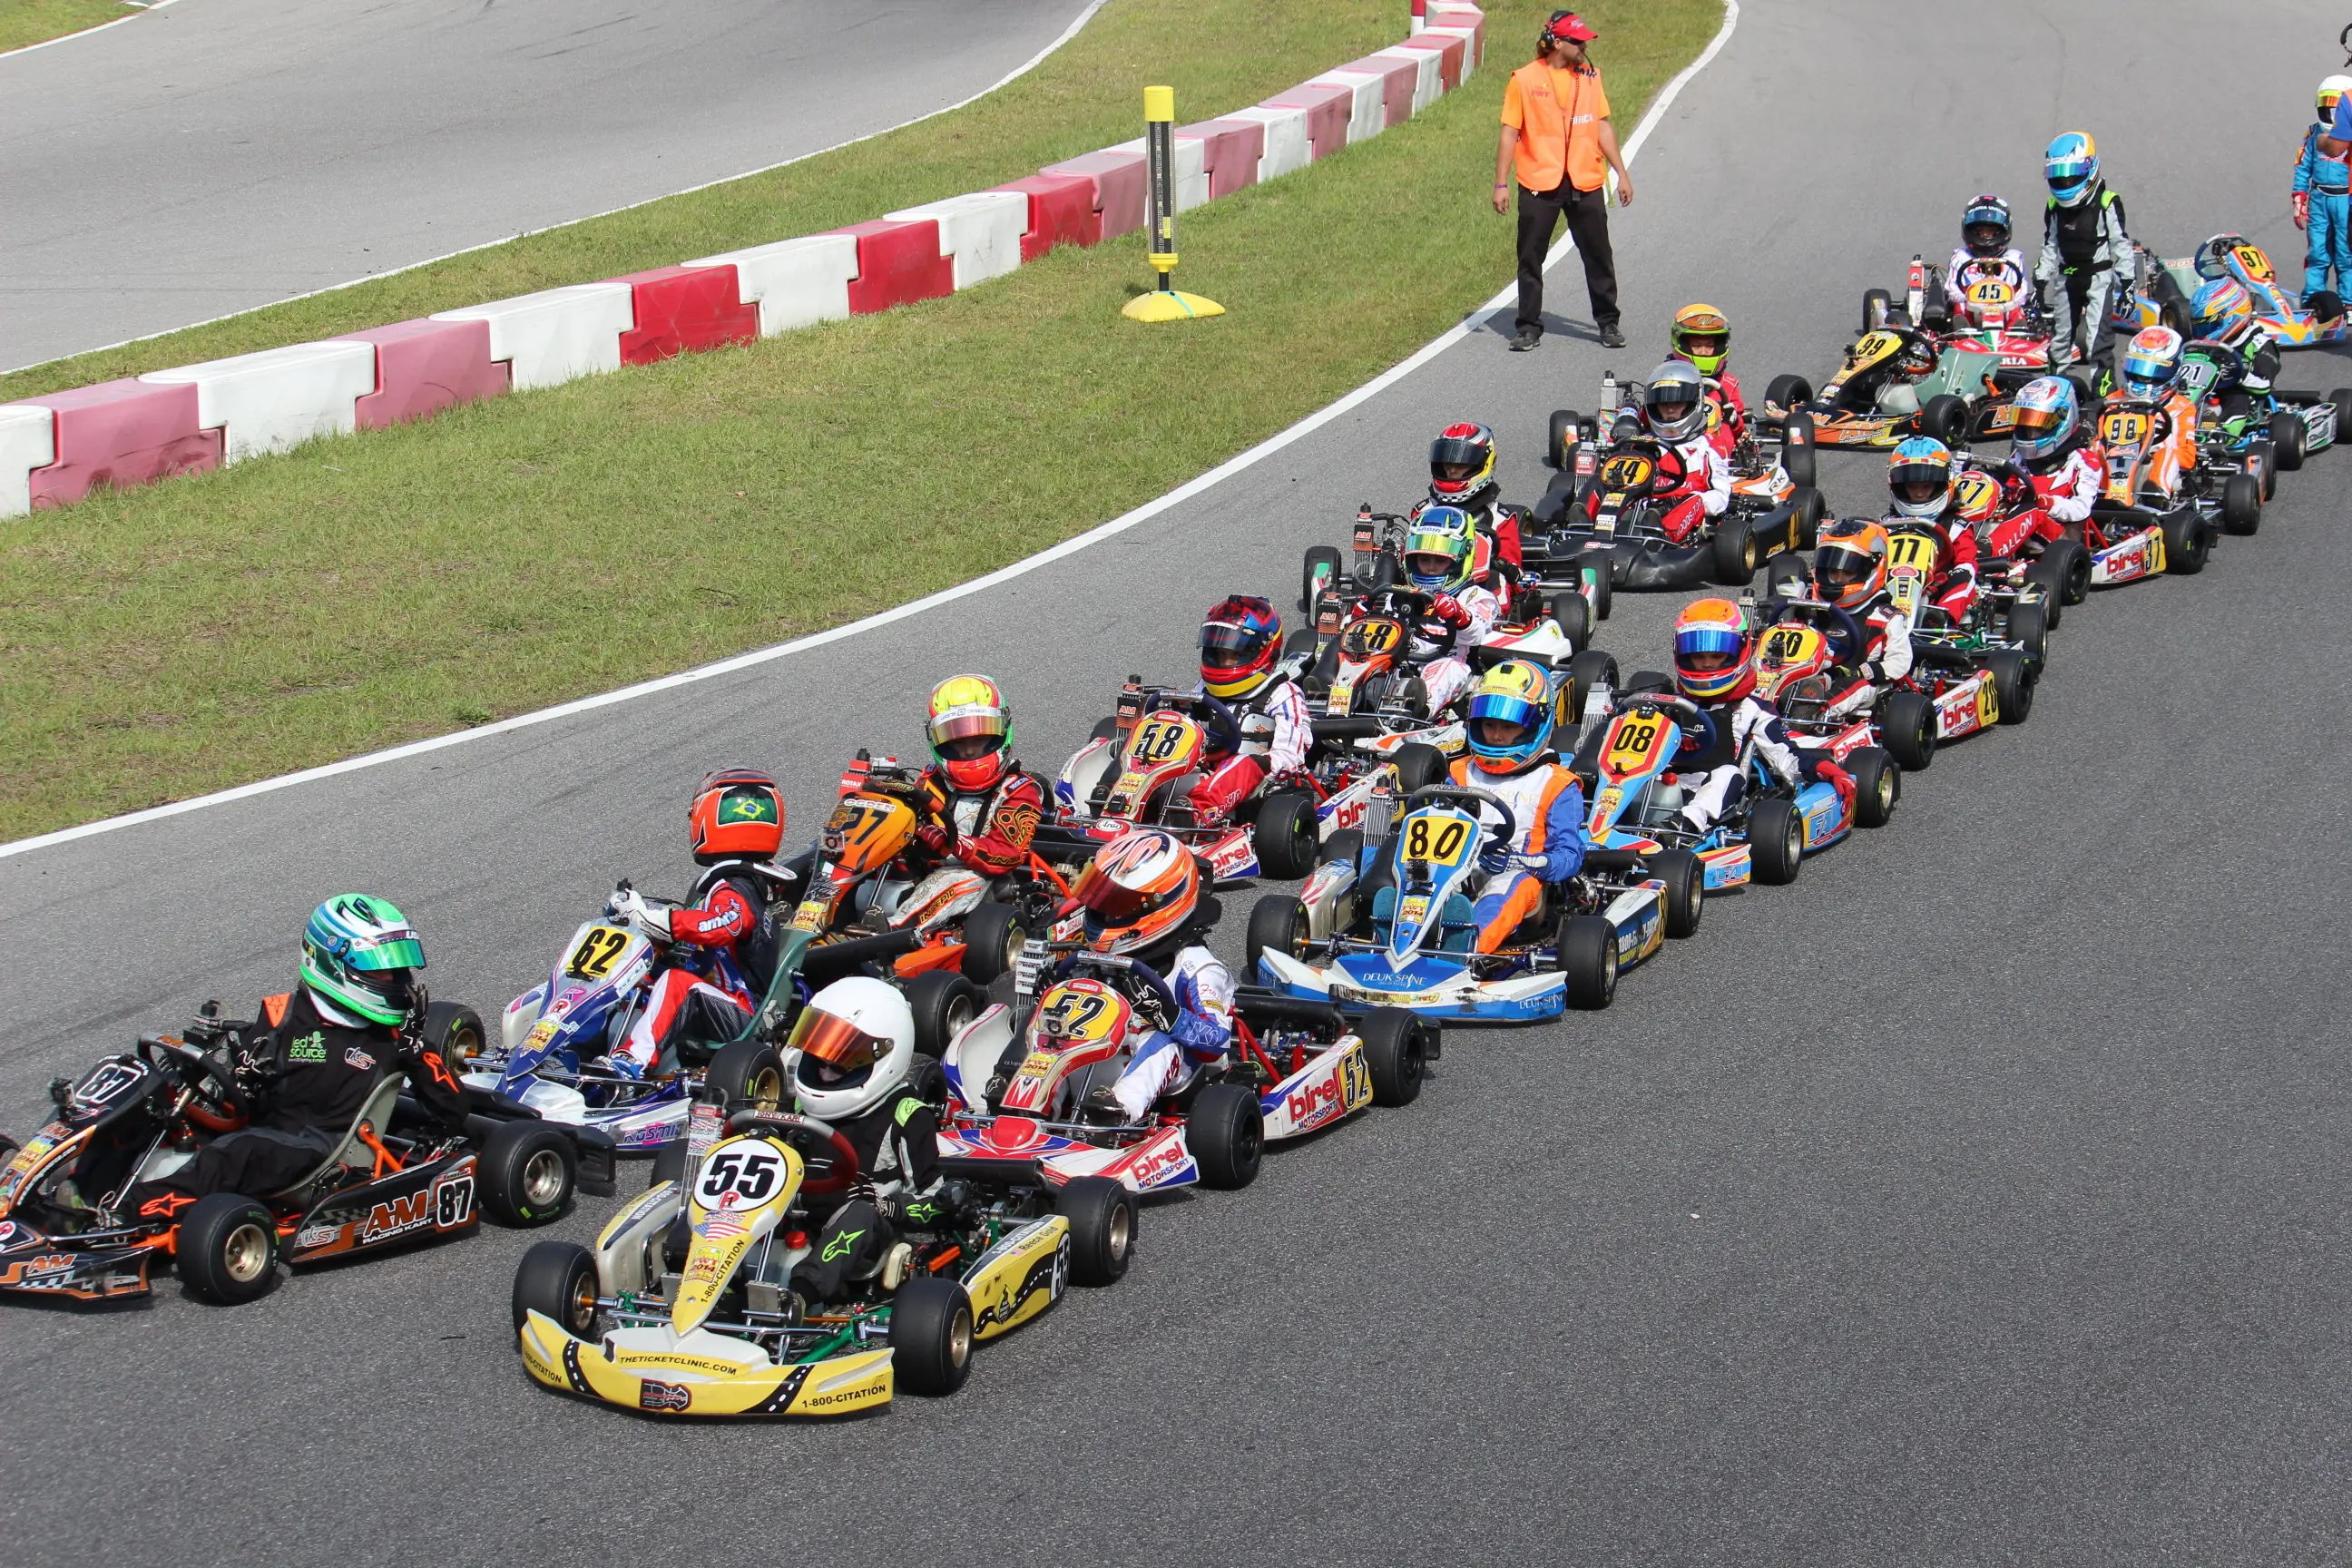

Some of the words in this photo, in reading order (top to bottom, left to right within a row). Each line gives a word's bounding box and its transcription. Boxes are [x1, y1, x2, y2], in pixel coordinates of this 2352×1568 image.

[2240, 250, 2264, 268] 97
[1977, 283, 2002, 300] 45
[1857, 338, 1887, 356] 99
[2181, 364, 2203, 382] 21
[2110, 418, 2137, 441] 98
[1355, 531, 1372, 540] AM
[2106, 548, 2142, 574] birel
[1319, 612, 1338, 621] AM
[1118, 705, 1137, 715] AM
[1983, 678, 1997, 717] 20
[1943, 692, 1978, 730] birel
[1133, 722, 1185, 760] 58
[1612, 723, 1656, 754] 08
[1097, 818, 1123, 832] Arai
[1408, 818, 1465, 860] 80
[797, 916, 816, 925] 2014
[571, 928, 628, 975] 62
[1363, 973, 1395, 983] DEUK
[1396, 974, 1428, 988] SPINE
[1544, 993, 1563, 1009] SPIN
[1052, 991, 1109, 1039] 52
[289, 1047, 327, 1059] source
[292, 1035, 309, 1049] led
[75, 1063, 142, 1104] 87
[1344, 1045, 1369, 1110] 52
[1287, 1067, 1341, 1123] birel
[1298, 1101, 1337, 1131] MOTORSPORT
[1130, 1141, 1185, 1182] birel
[1138, 1158, 1190, 1191] MOTORSPORT
[702, 1152, 779, 1200] 55
[436, 1177, 475, 1228] 87
[362, 1226, 404, 1245] RACING
[404, 1218, 434, 1232] KART
[1018, 1236, 1044, 1251] Reece
[1041, 1225, 1059, 1239] Gold
[25, 1255, 79, 1275] AM
[691, 1263, 716, 1272] 2014
[700, 1238, 745, 1304] 1-800-CITATION
[620, 1356, 738, 1377] THETICKETCLINIC.COM
[801, 1384, 887, 1410] 1-800-CITATION
